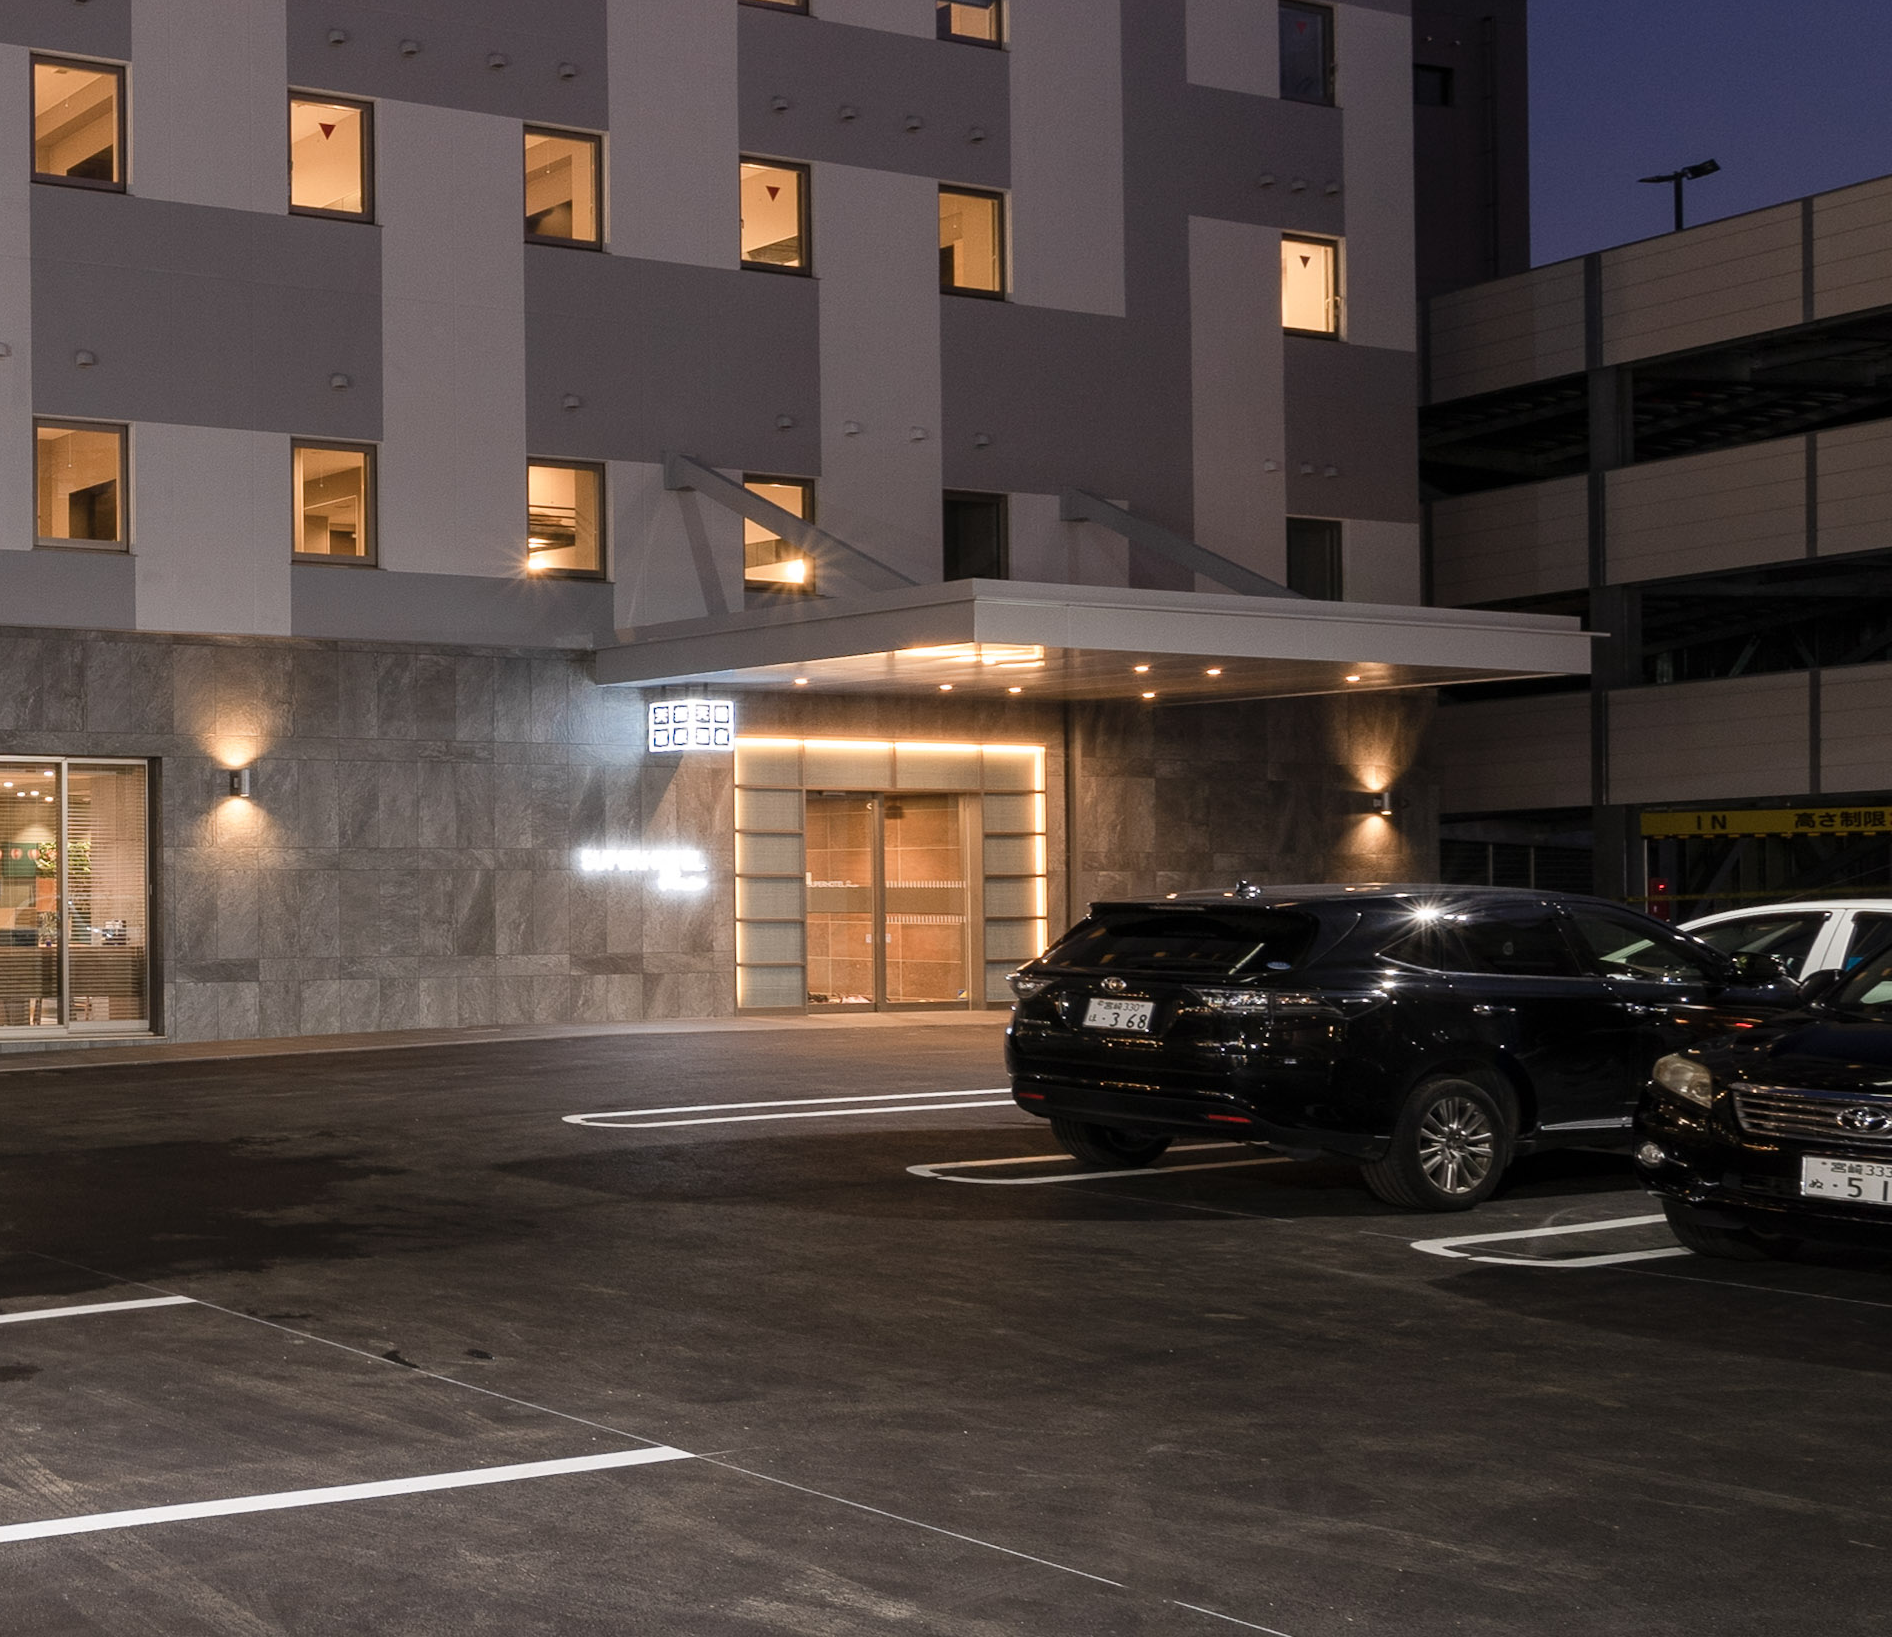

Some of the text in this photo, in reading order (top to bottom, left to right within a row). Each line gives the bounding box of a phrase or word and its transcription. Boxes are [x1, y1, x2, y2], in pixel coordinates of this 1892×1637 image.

[1696, 814, 1727, 830] IN
[1794, 811, 1885, 829] 高さ制限
